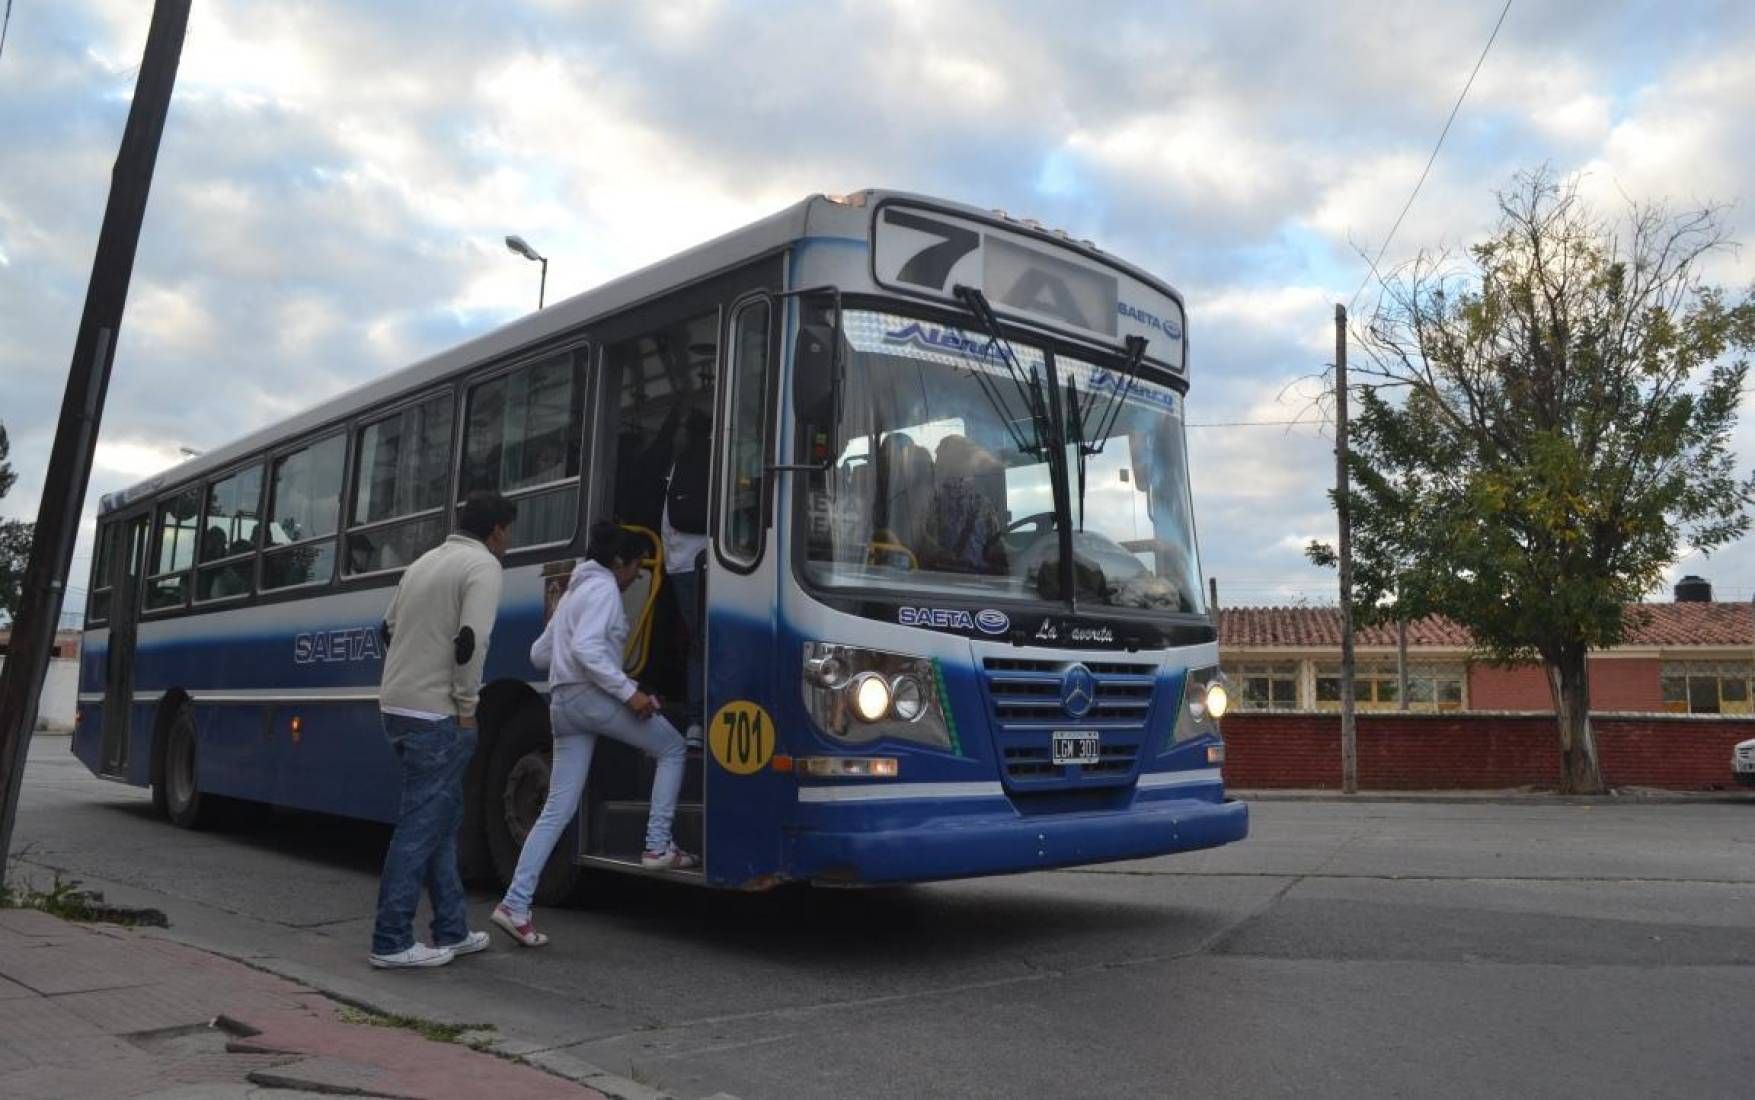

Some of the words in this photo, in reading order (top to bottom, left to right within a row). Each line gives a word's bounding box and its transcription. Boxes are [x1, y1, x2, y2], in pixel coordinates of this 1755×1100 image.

[884, 208, 980, 291] 7
[1003, 266, 1092, 331] A
[1117, 302, 1161, 331] SAETA
[899, 606, 973, 629] SAETA
[1035, 616, 1057, 640] La
[295, 626, 381, 664] SAETA
[723, 709, 763, 765] 701
[1079, 740, 1097, 757] 301
